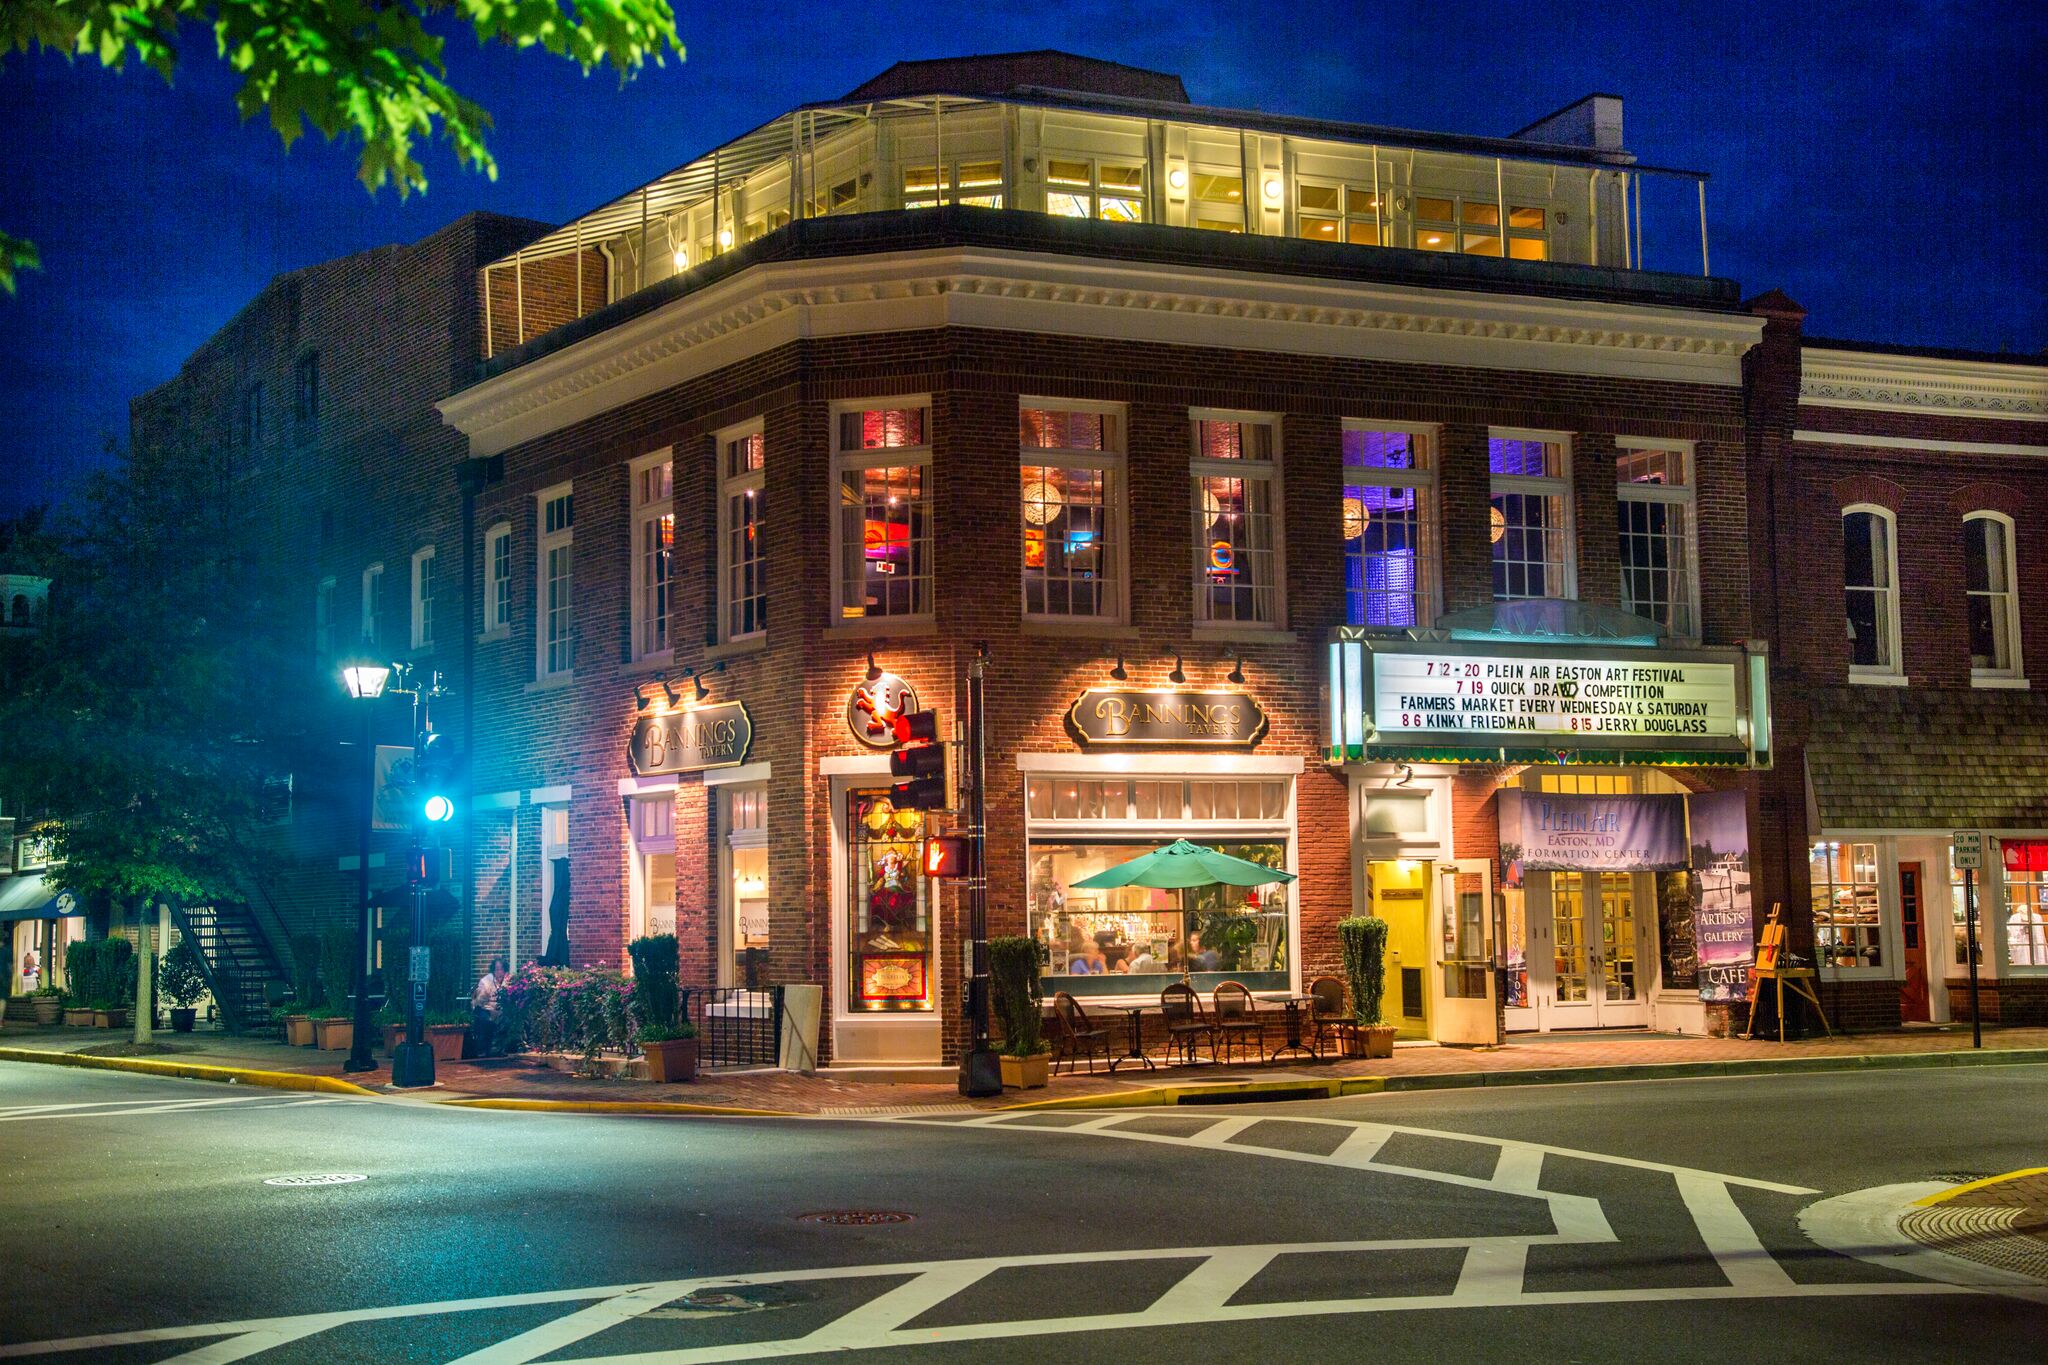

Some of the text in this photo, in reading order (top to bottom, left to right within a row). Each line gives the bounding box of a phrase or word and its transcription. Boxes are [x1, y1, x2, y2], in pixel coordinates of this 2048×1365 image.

[1427, 662, 1434, 675] 7
[1439, 663, 1450, 676] 12
[1465, 664, 1480, 677] 20
[1487, 665, 1523, 678] PLEIN
[1530, 665, 1550, 679] AIR
[1556, 667, 1601, 680] EASTON
[1606, 668, 1628, 681] ART
[1632, 669, 1685, 682] FESTIVAL
[1456, 681, 1463, 693] 7
[1472, 681, 1483, 694] 19
[1491, 682, 1525, 695] QUICK
[1584, 684, 1664, 699] COMPETITION
[1401, 696, 1707, 716] FARMERS MARKET EVERY WEDNESDAY & SATURDAY
[1096, 698, 1241, 736] BANNINGS
[1402, 714, 1707, 733] 8 6 KINKY FRIEDMAN 8 15 JERRY DOUGLASS
[1187, 725, 1240, 736] TAVERN
[645, 719, 736, 767] BANNINGS
[699, 743, 734, 759] TAVERN
[1541, 801, 1620, 832] PLEIN AIR
[1548, 835, 1615, 847] EASTON, MD
[1604, 849, 1650, 859] CENTER
[1956, 846, 1980, 854] PARKING
[1961, 856, 1976, 864] ONLY
[1700, 912, 1746, 925] ARTISTS
[1704, 931, 1744, 942] GALLERY
